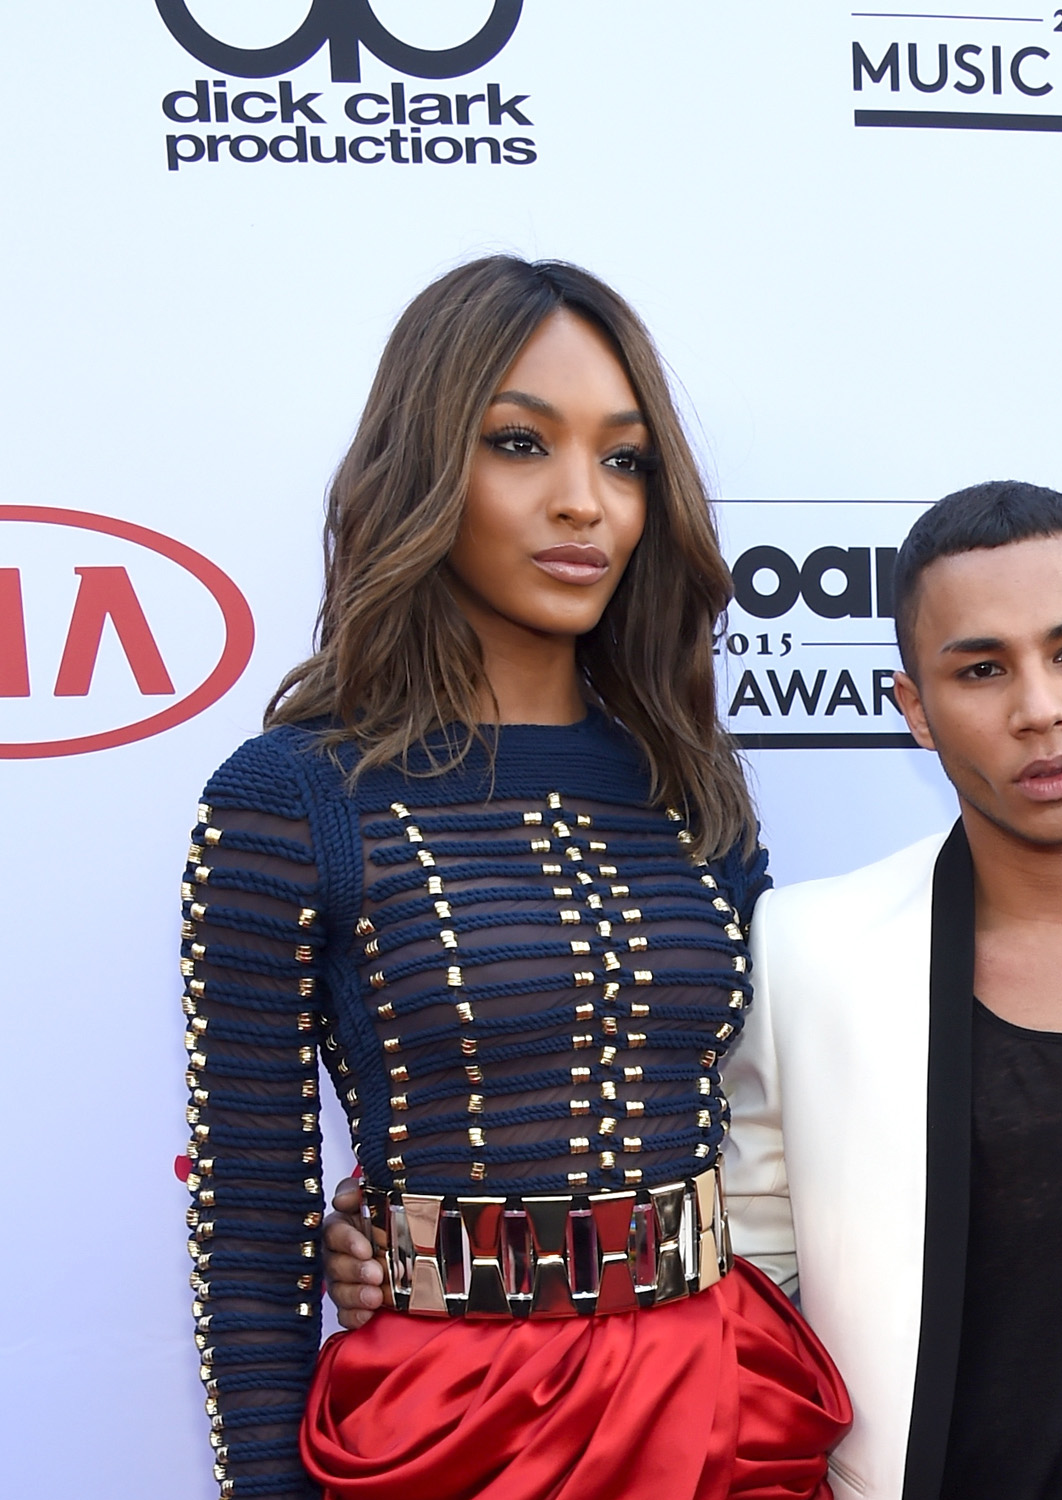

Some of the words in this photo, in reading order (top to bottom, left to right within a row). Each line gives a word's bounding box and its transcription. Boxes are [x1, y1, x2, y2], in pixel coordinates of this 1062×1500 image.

[852, 41, 1054, 97] MUSIC
[162, 80, 328, 123] dick
[344, 83, 534, 126] clark
[165, 126, 538, 171] productions
[0, 566, 175, 697] IA
[728, 669, 905, 716] AWAR
